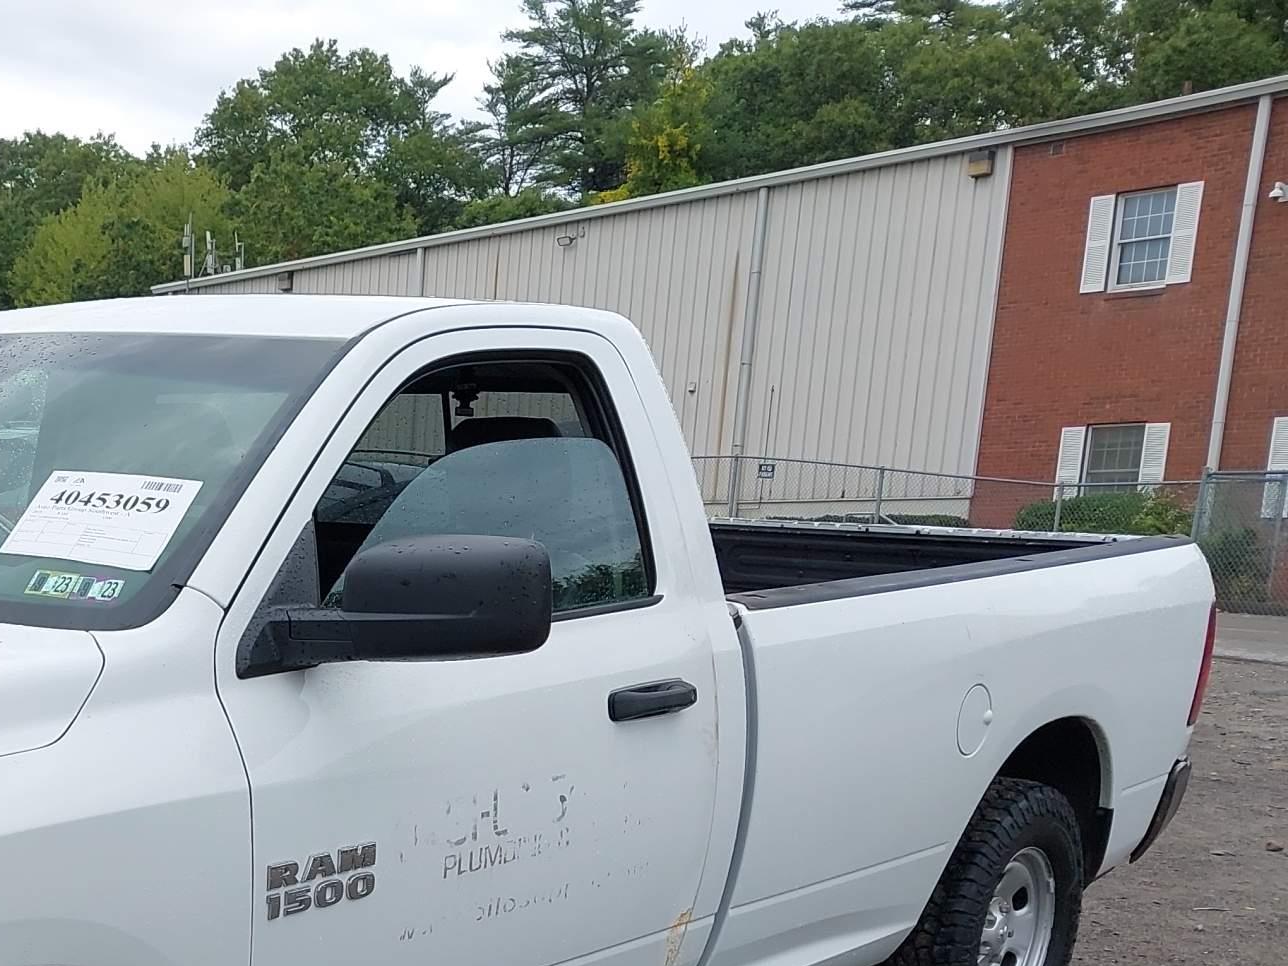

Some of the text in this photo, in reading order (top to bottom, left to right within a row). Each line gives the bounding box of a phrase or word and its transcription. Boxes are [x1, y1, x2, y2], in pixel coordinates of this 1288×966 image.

[50, 489, 170, 514] 40453059
[54, 576, 72, 593] 23
[101, 581, 119, 598] 23
[266, 842, 377, 892] RAM
[266, 871, 376, 921] 1500
